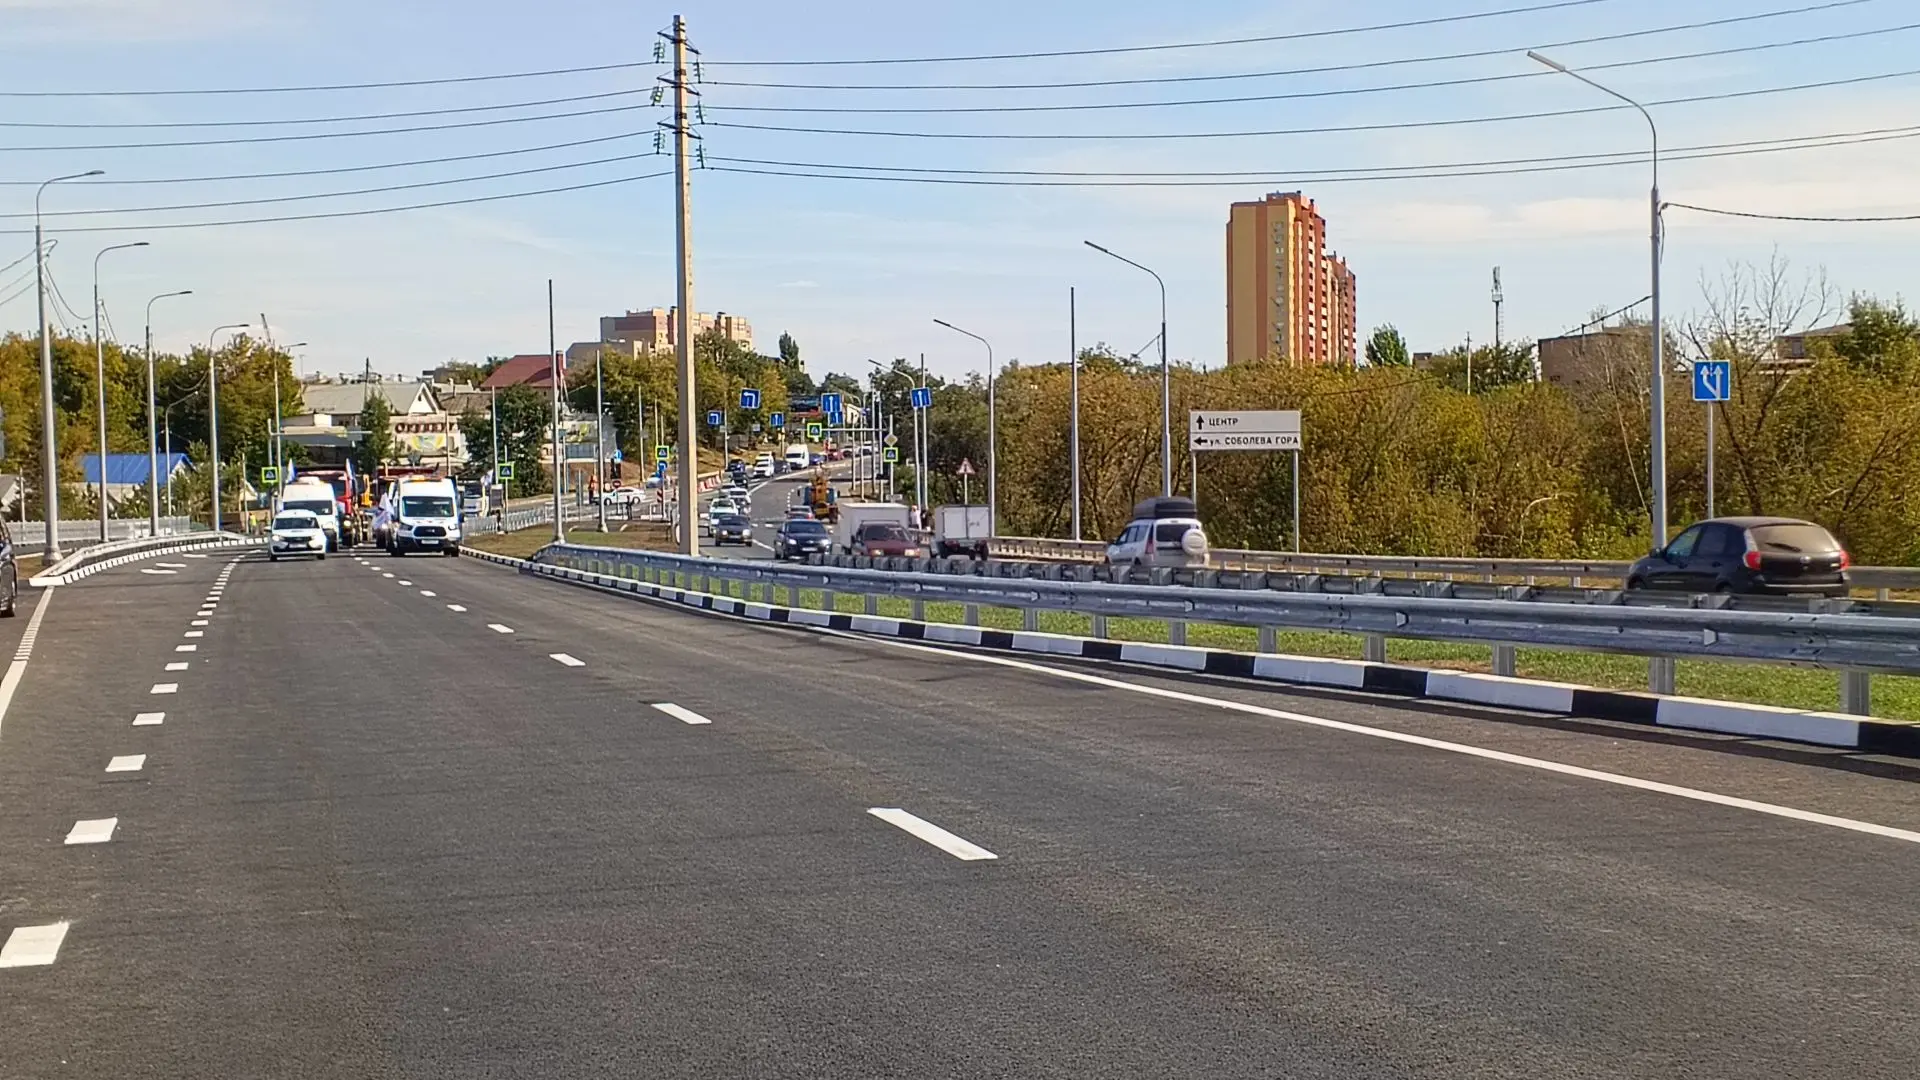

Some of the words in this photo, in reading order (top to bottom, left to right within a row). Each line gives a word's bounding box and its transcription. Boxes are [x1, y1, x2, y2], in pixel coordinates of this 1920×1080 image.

[1208, 417, 1239, 427] ЦЕНТР
[1224, 436, 1273, 445] СОБОЛЕВА
[1275, 436, 1299, 445] ГОРА
